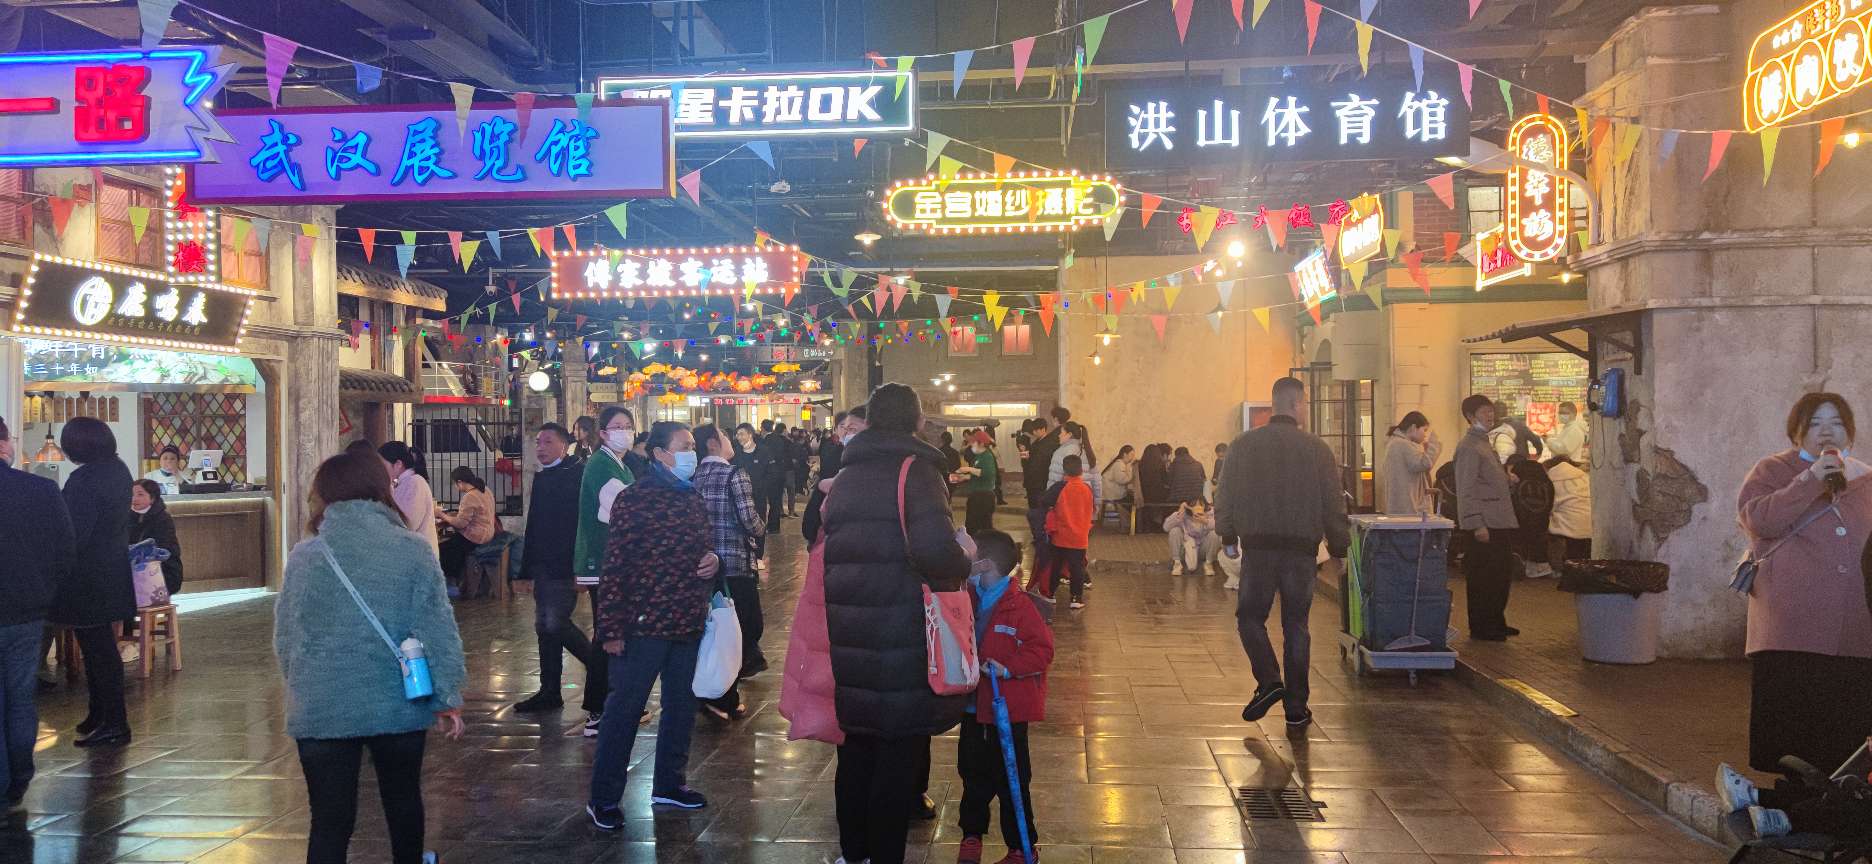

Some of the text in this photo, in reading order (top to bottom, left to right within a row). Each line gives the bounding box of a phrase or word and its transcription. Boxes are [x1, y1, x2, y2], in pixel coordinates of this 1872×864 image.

[634, 85, 884, 125] 星卡拉OK
[1128, 91, 1450, 151] 洪山体育馆
[251, 116, 600, 191] 武汉展览馆
